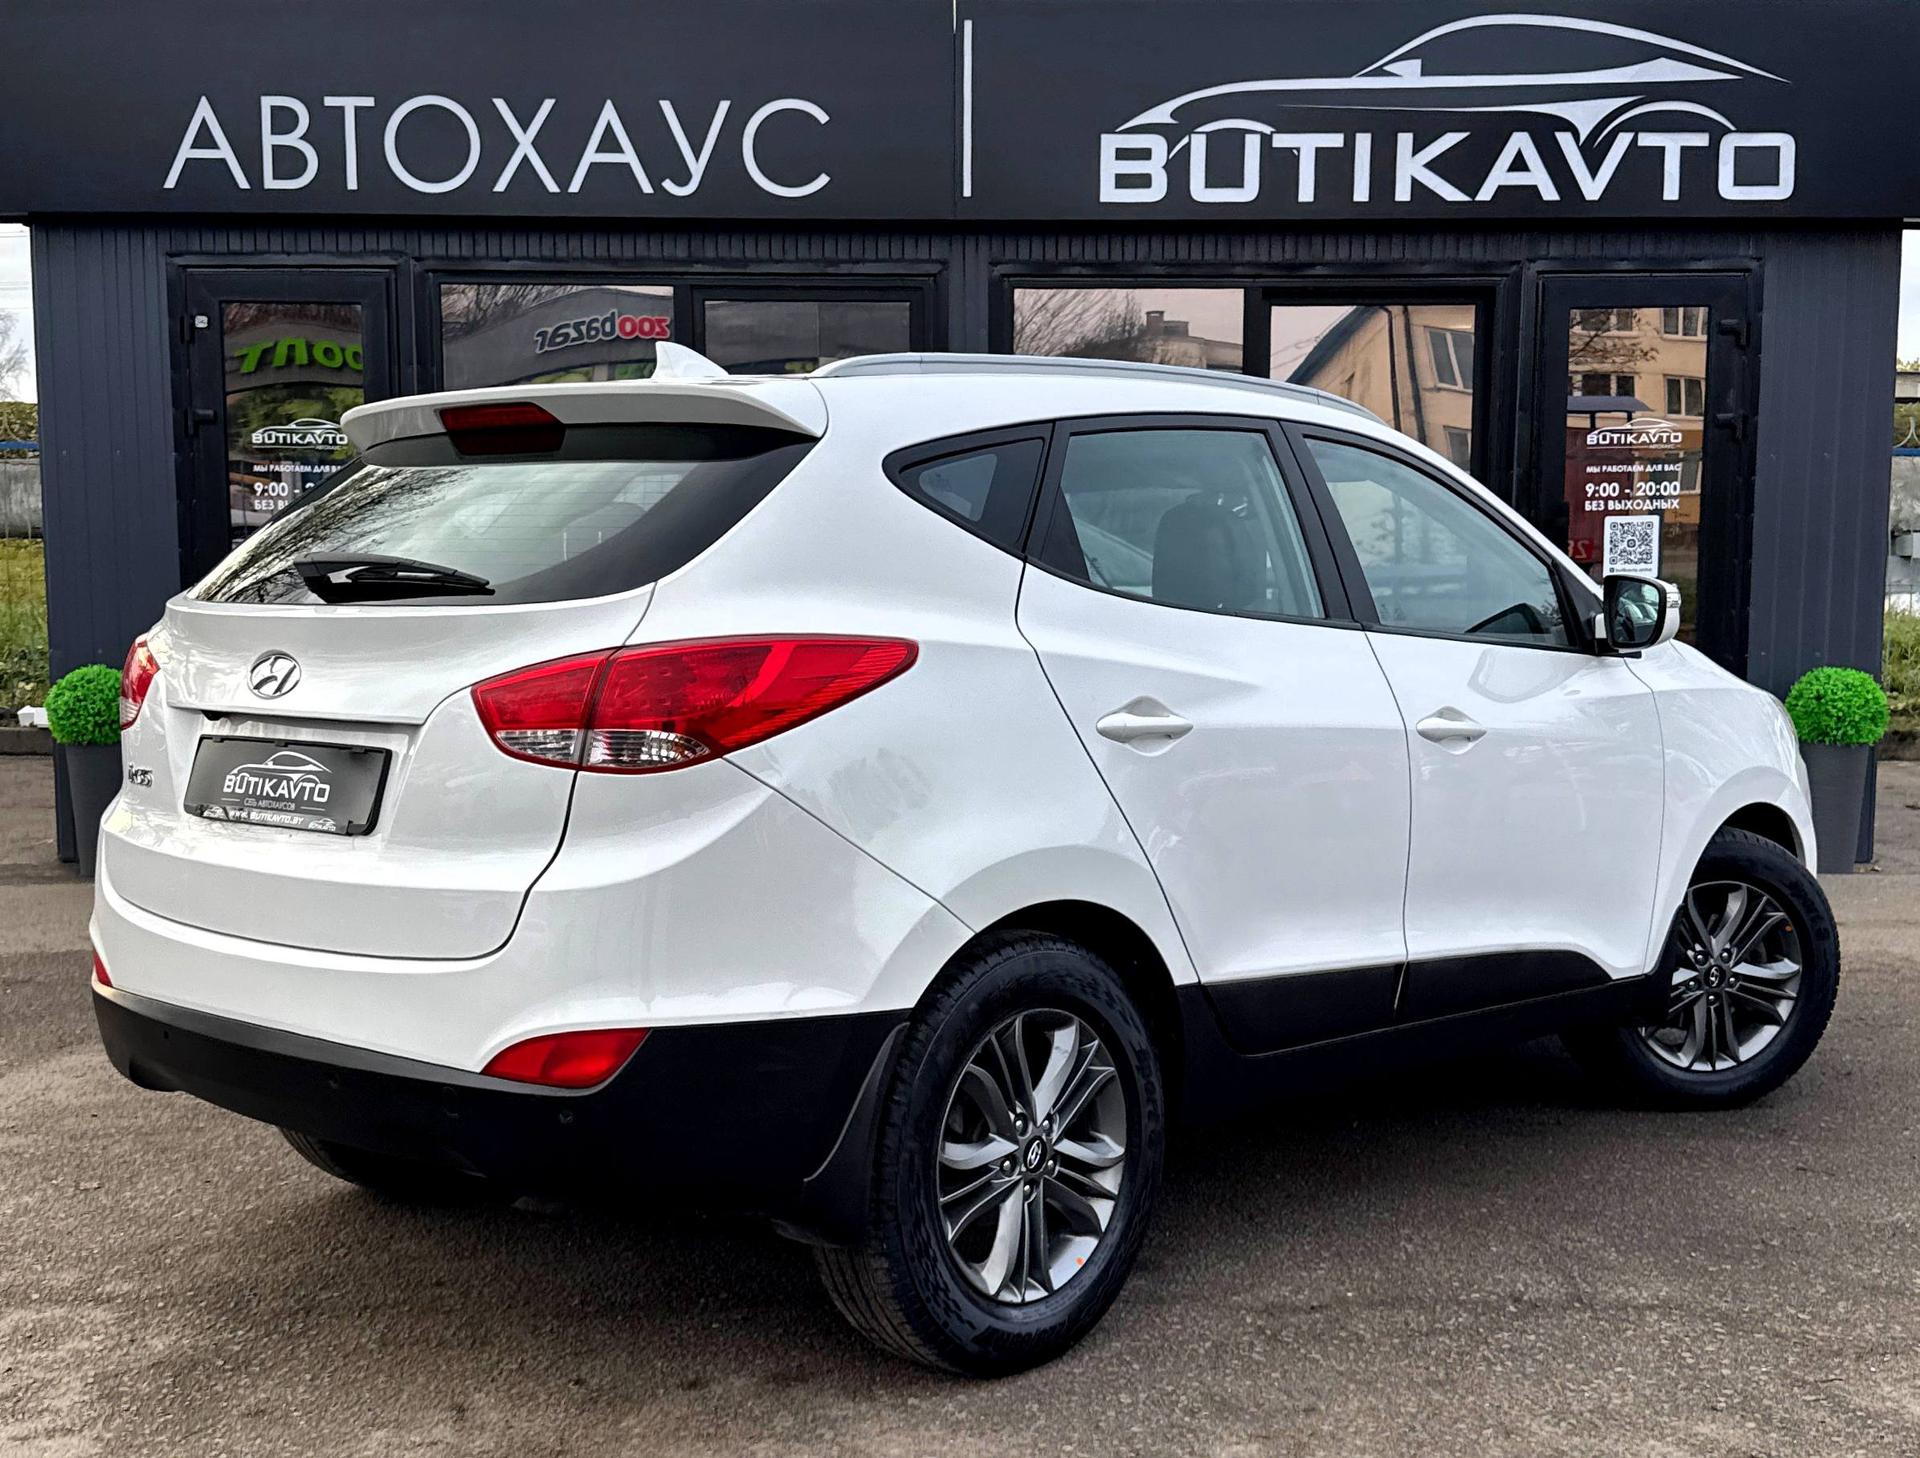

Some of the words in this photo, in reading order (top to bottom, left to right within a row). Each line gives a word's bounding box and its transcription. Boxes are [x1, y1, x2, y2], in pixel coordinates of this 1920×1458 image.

[163, 94, 831, 199] АВТОХАУС
[1099, 131, 1796, 204] BUTIKAVTO
[251, 431, 348, 445] BUTIKAVTO
[1586, 432, 1682, 445] BUTIKAVTO
[269, 465, 312, 473] РАБОТАЕМ
[312, 465, 331, 473] ДЛЯ
[1586, 465, 1600, 473] МЫ
[1601, 464, 1645, 473] РАБОТАЕМ
[1645, 464, 1662, 472] ДЛЯ
[1664, 463, 1681, 471] ВАС
[253, 482, 288, 496] 9:00
[1585, 482, 1619, 497] 9:00
[1635, 481, 1680, 496] 20:00
[254, 500, 274, 511] БЕЗ
[1584, 501, 1605, 512] БЕЗ
[1607, 499, 1680, 511] ВЫХОДНЫХ
[223, 774, 331, 803] BUTIKAVTO
